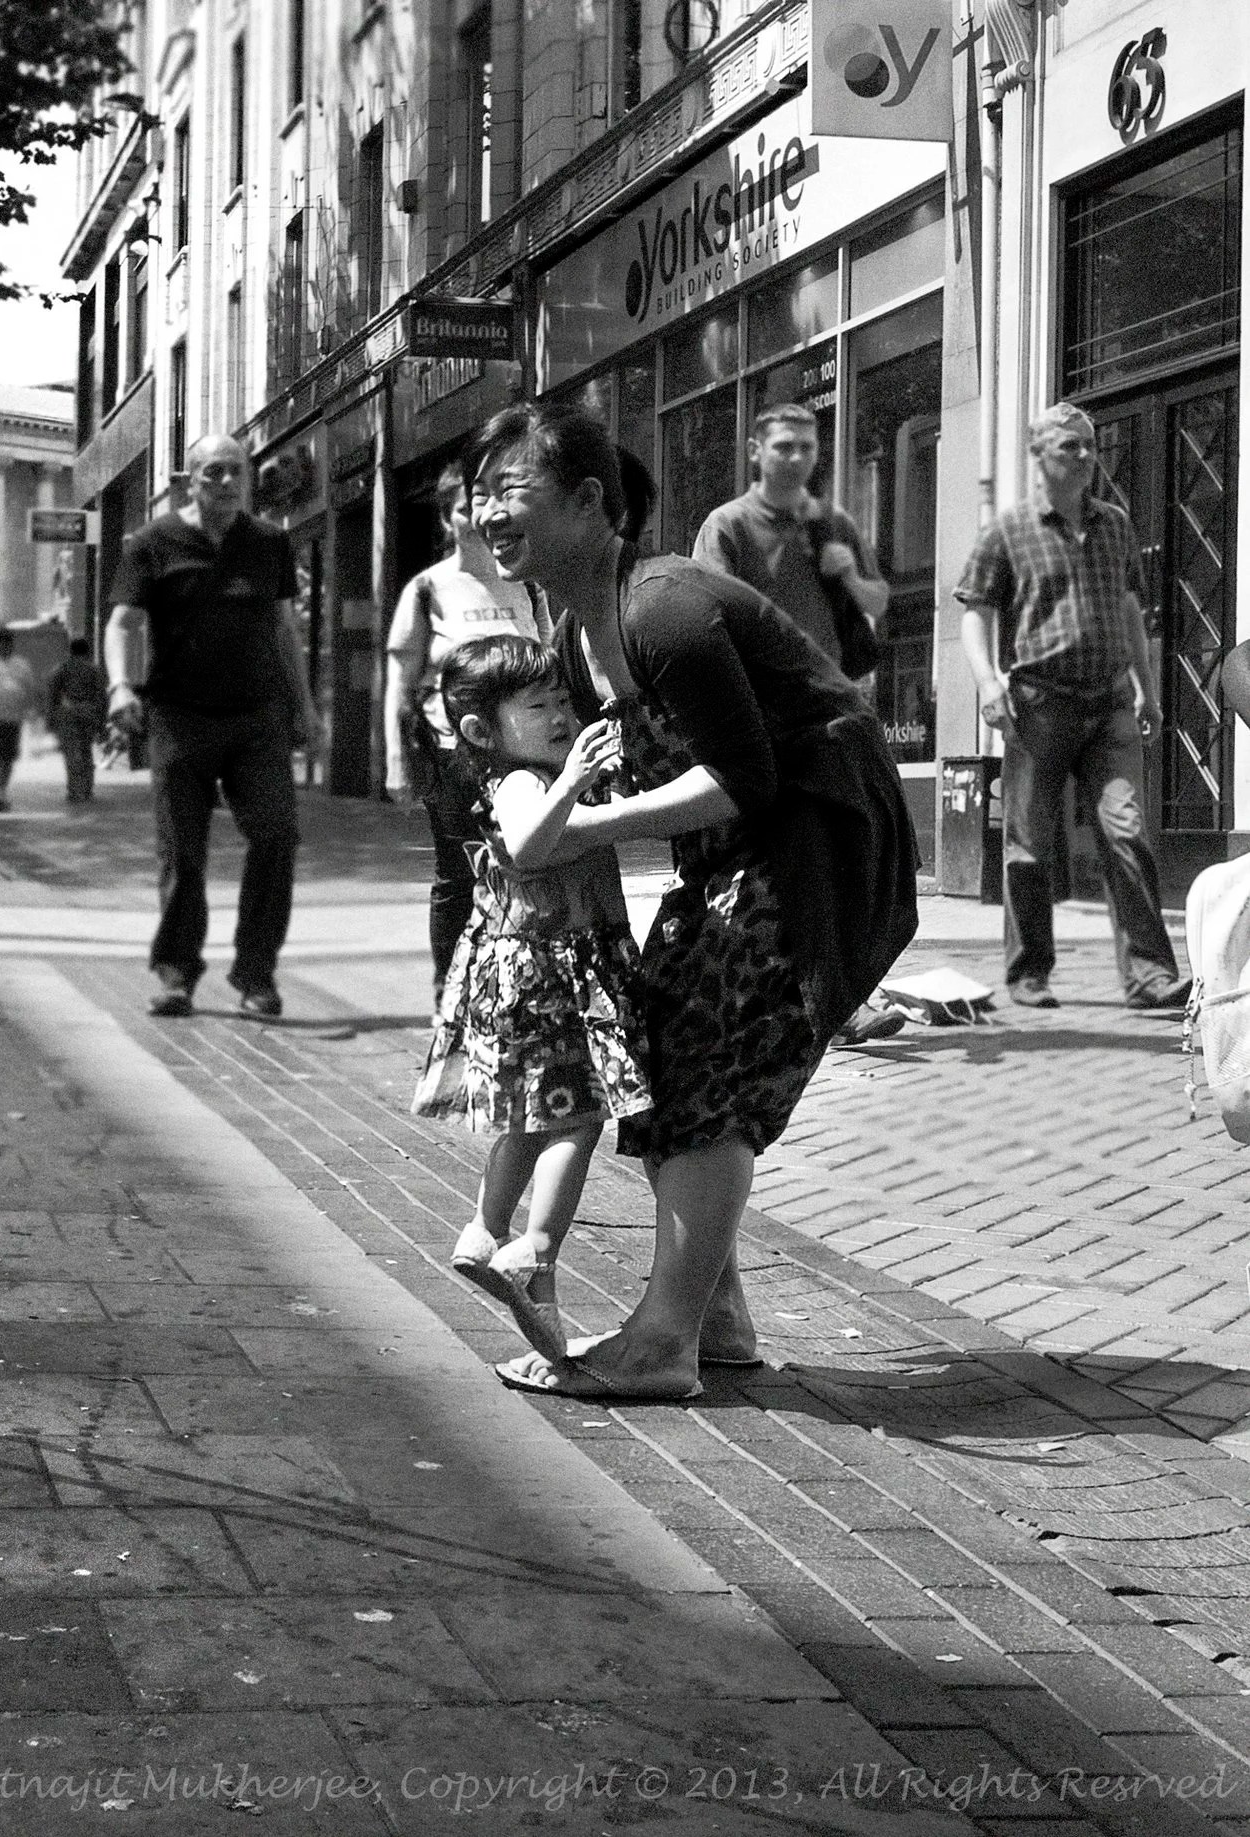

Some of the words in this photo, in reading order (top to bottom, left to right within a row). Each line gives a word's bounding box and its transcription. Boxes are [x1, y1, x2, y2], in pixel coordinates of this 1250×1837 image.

[1107, 27, 1167, 140] 65
[638, 133, 804, 324] Yorkshire
[656, 262, 723, 315] BUILDING
[733, 216, 801, 271] SOCIETY
[416, 317, 508, 339] Britannia
[820, 359, 836, 381] 100
